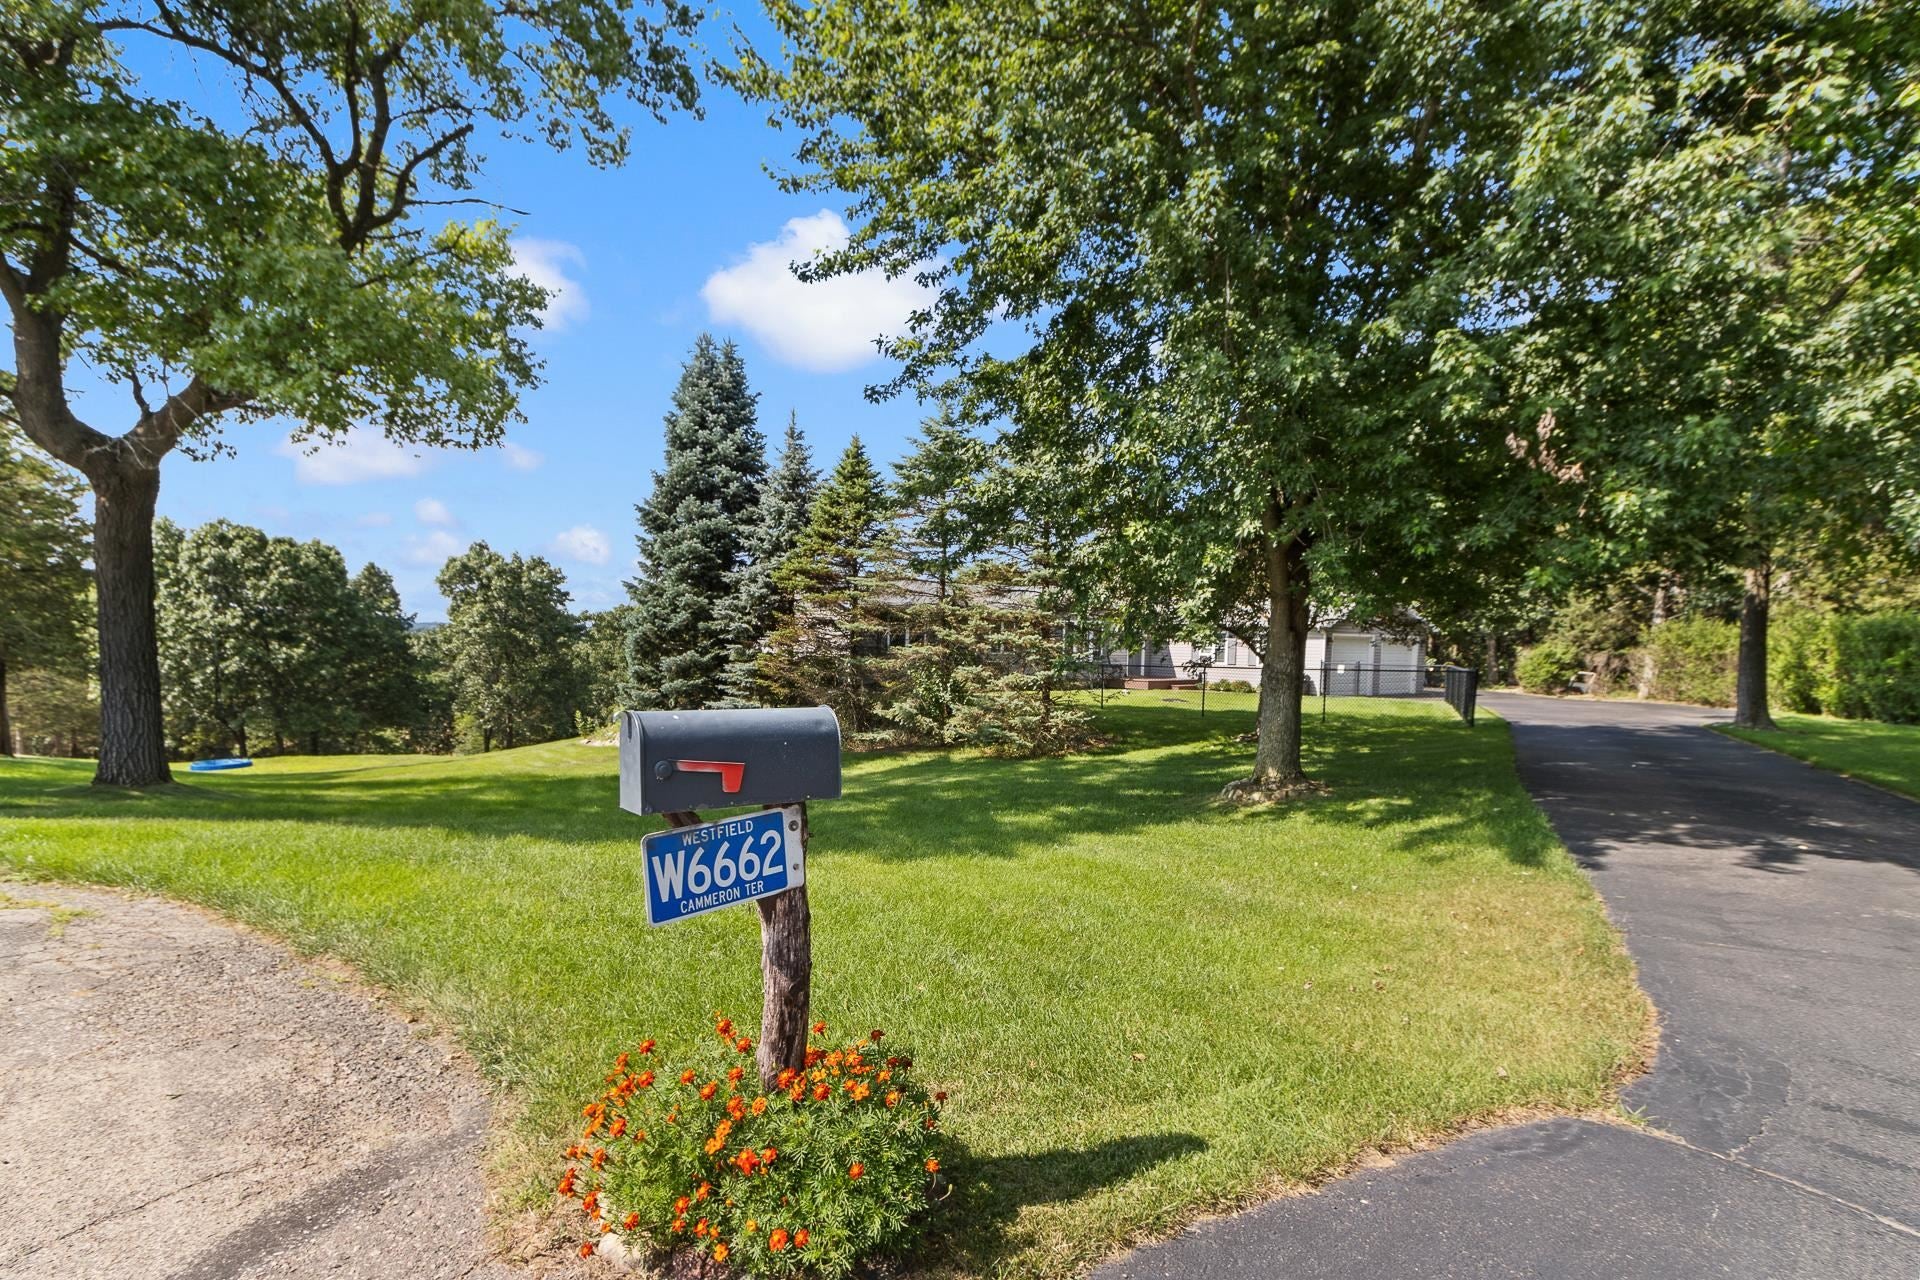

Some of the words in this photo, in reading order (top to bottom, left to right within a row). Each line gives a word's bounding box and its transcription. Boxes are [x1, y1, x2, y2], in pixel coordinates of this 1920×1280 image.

[682, 821, 754, 846] WESTFIELD
[652, 829, 784, 903] W6662
[680, 888, 741, 914] CAMMERON
[745, 880, 764, 895] TER
